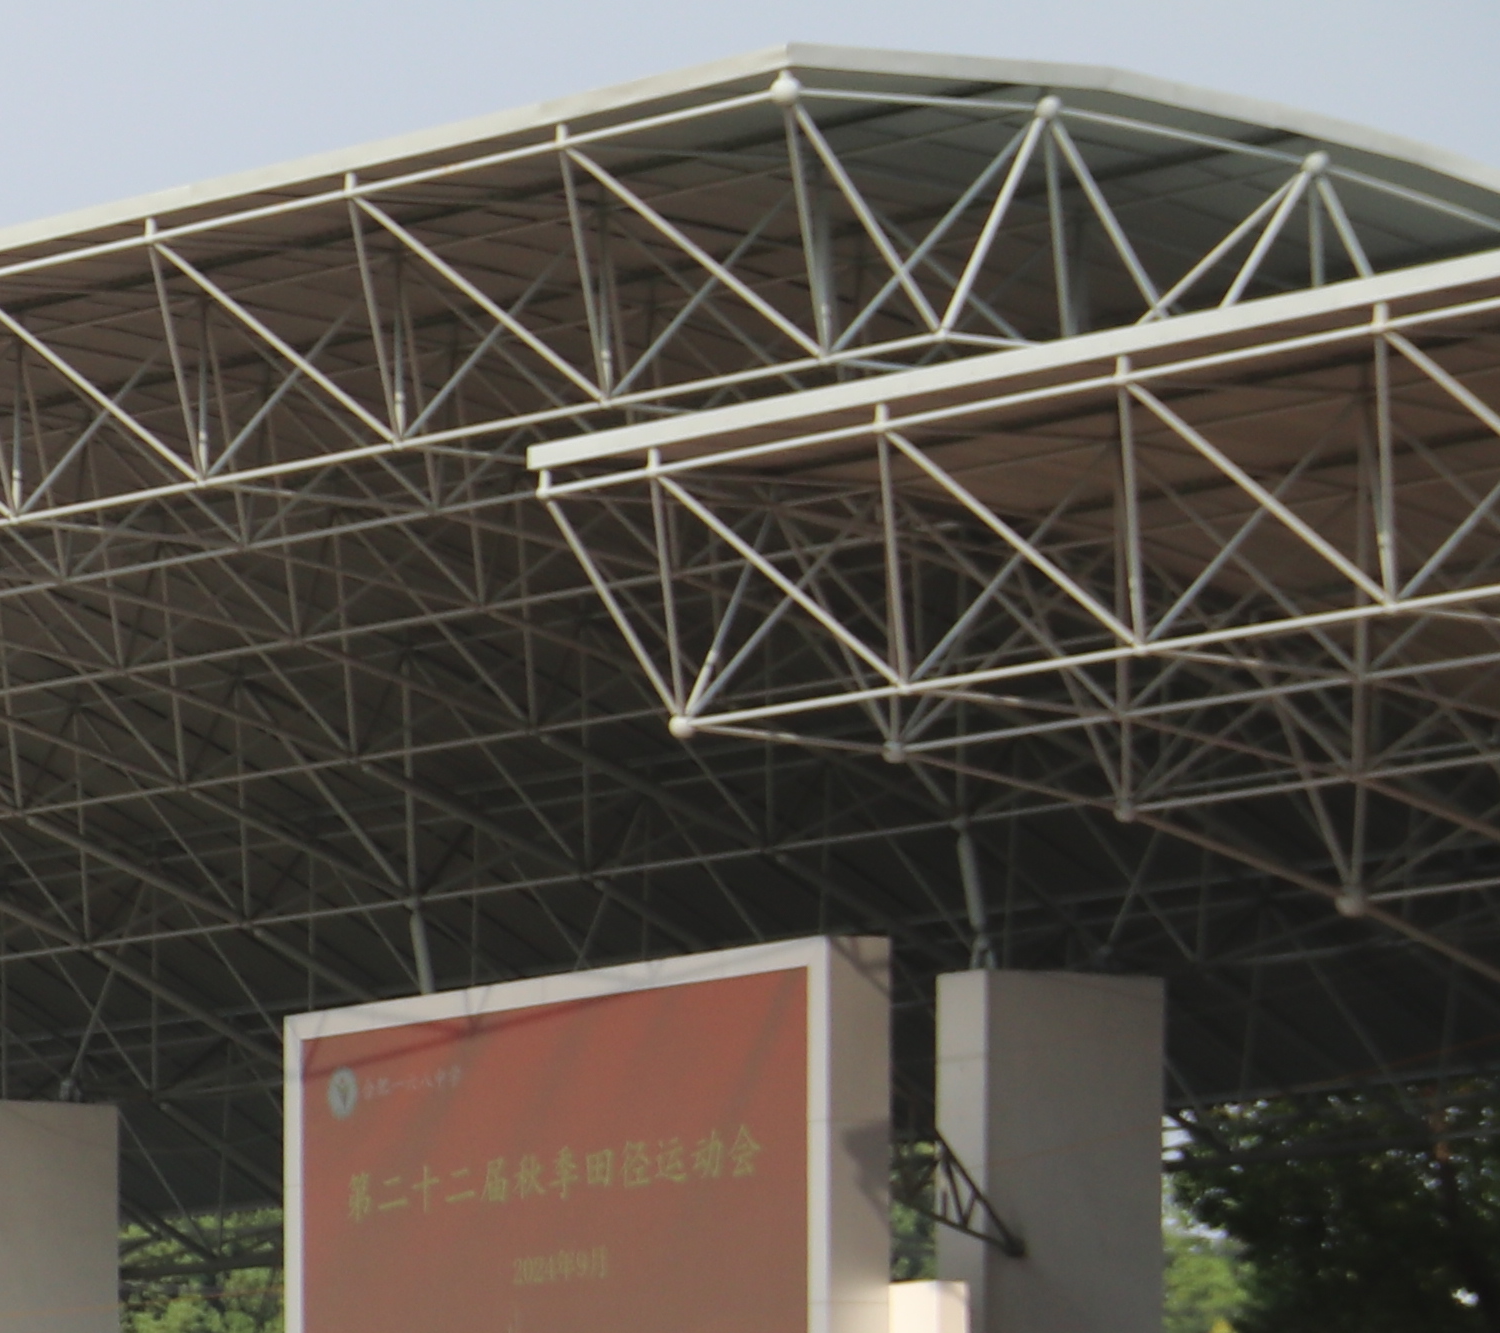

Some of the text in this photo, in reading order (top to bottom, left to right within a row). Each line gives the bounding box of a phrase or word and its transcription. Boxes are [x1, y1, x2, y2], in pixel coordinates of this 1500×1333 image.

[348, 1124, 761, 1223] 第二十二届秋季田径运动会
